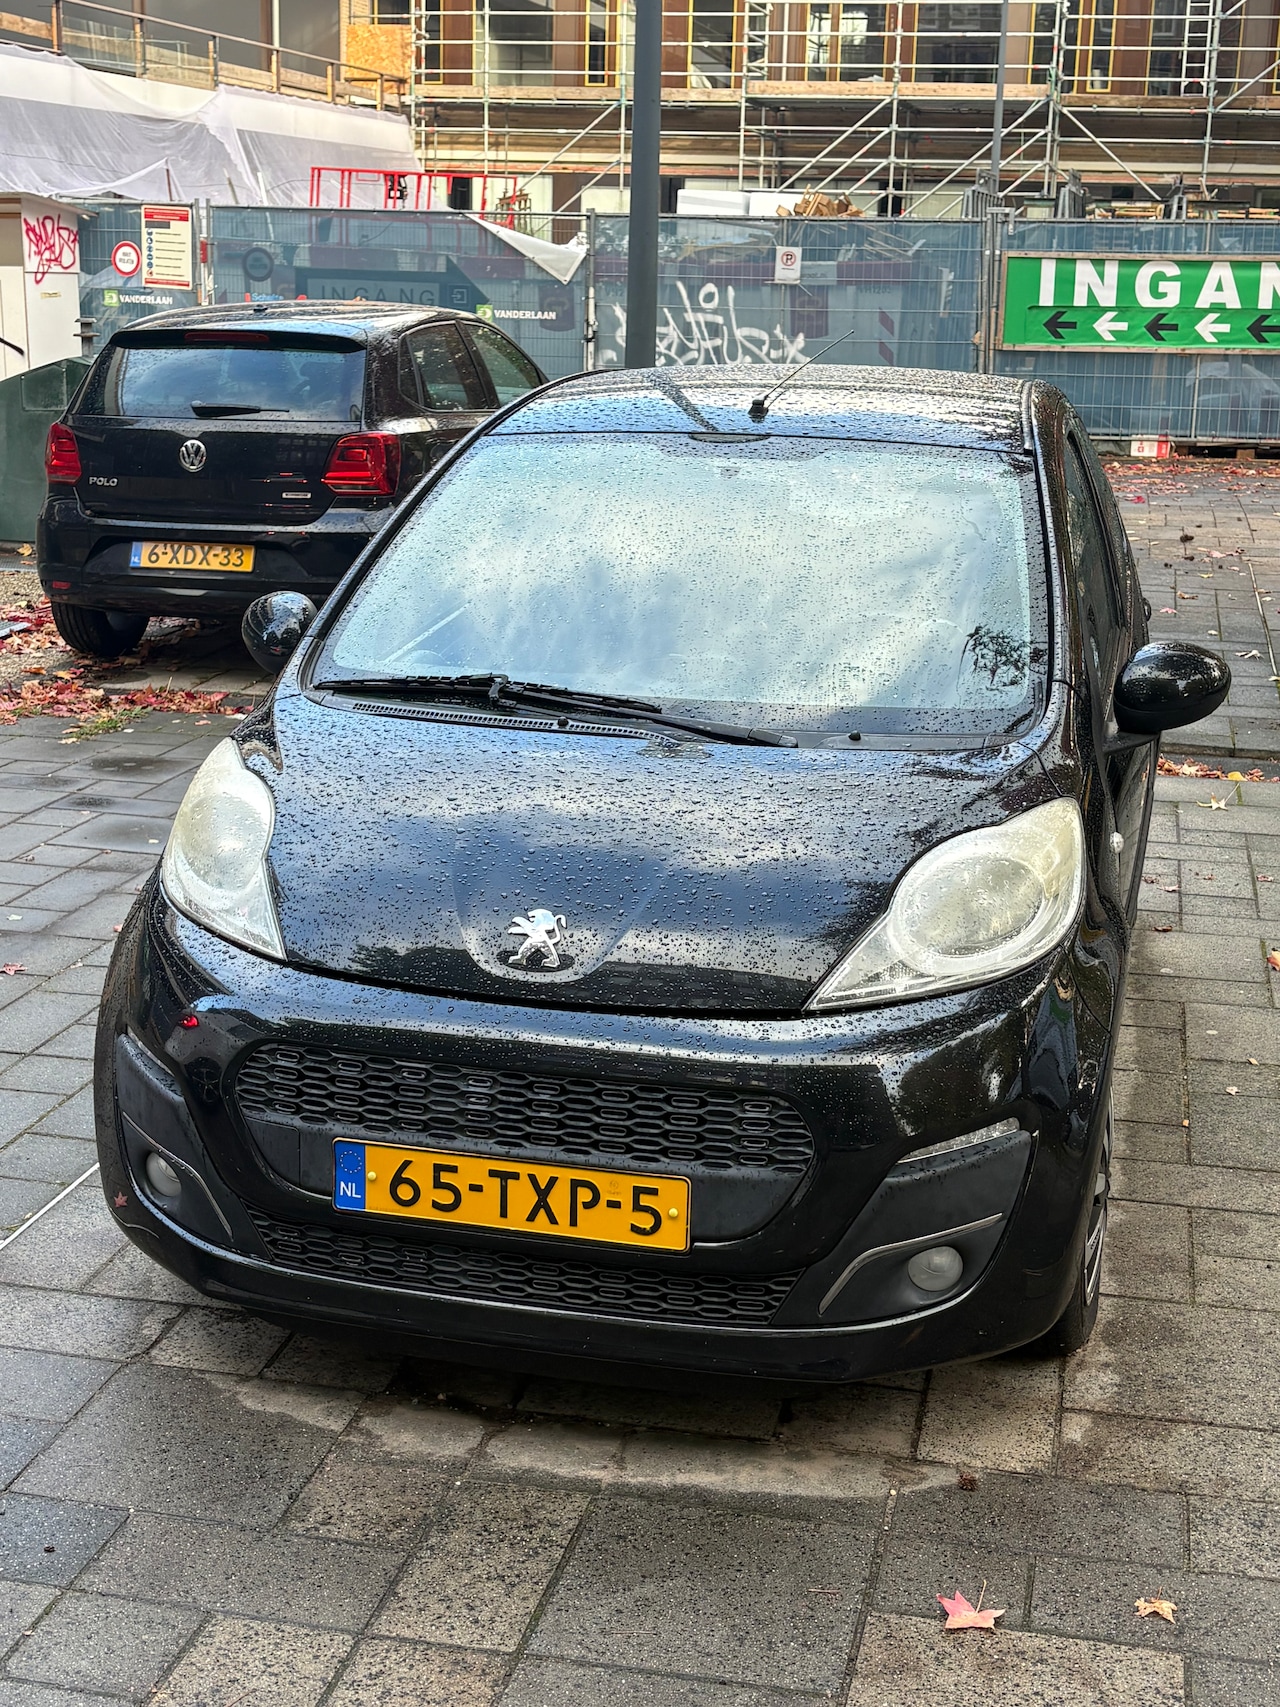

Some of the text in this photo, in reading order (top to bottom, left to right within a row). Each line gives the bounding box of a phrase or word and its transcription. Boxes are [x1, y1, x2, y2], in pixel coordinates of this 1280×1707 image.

[119, 294, 173, 305] VANDERLAAN
[493, 309, 557, 320] VANDERLAAN
[89, 476, 118, 487] POLO
[131, 543, 245, 567] NL 6-XDX-33
[339, 1159, 662, 1236] NL 65-TXP-5
